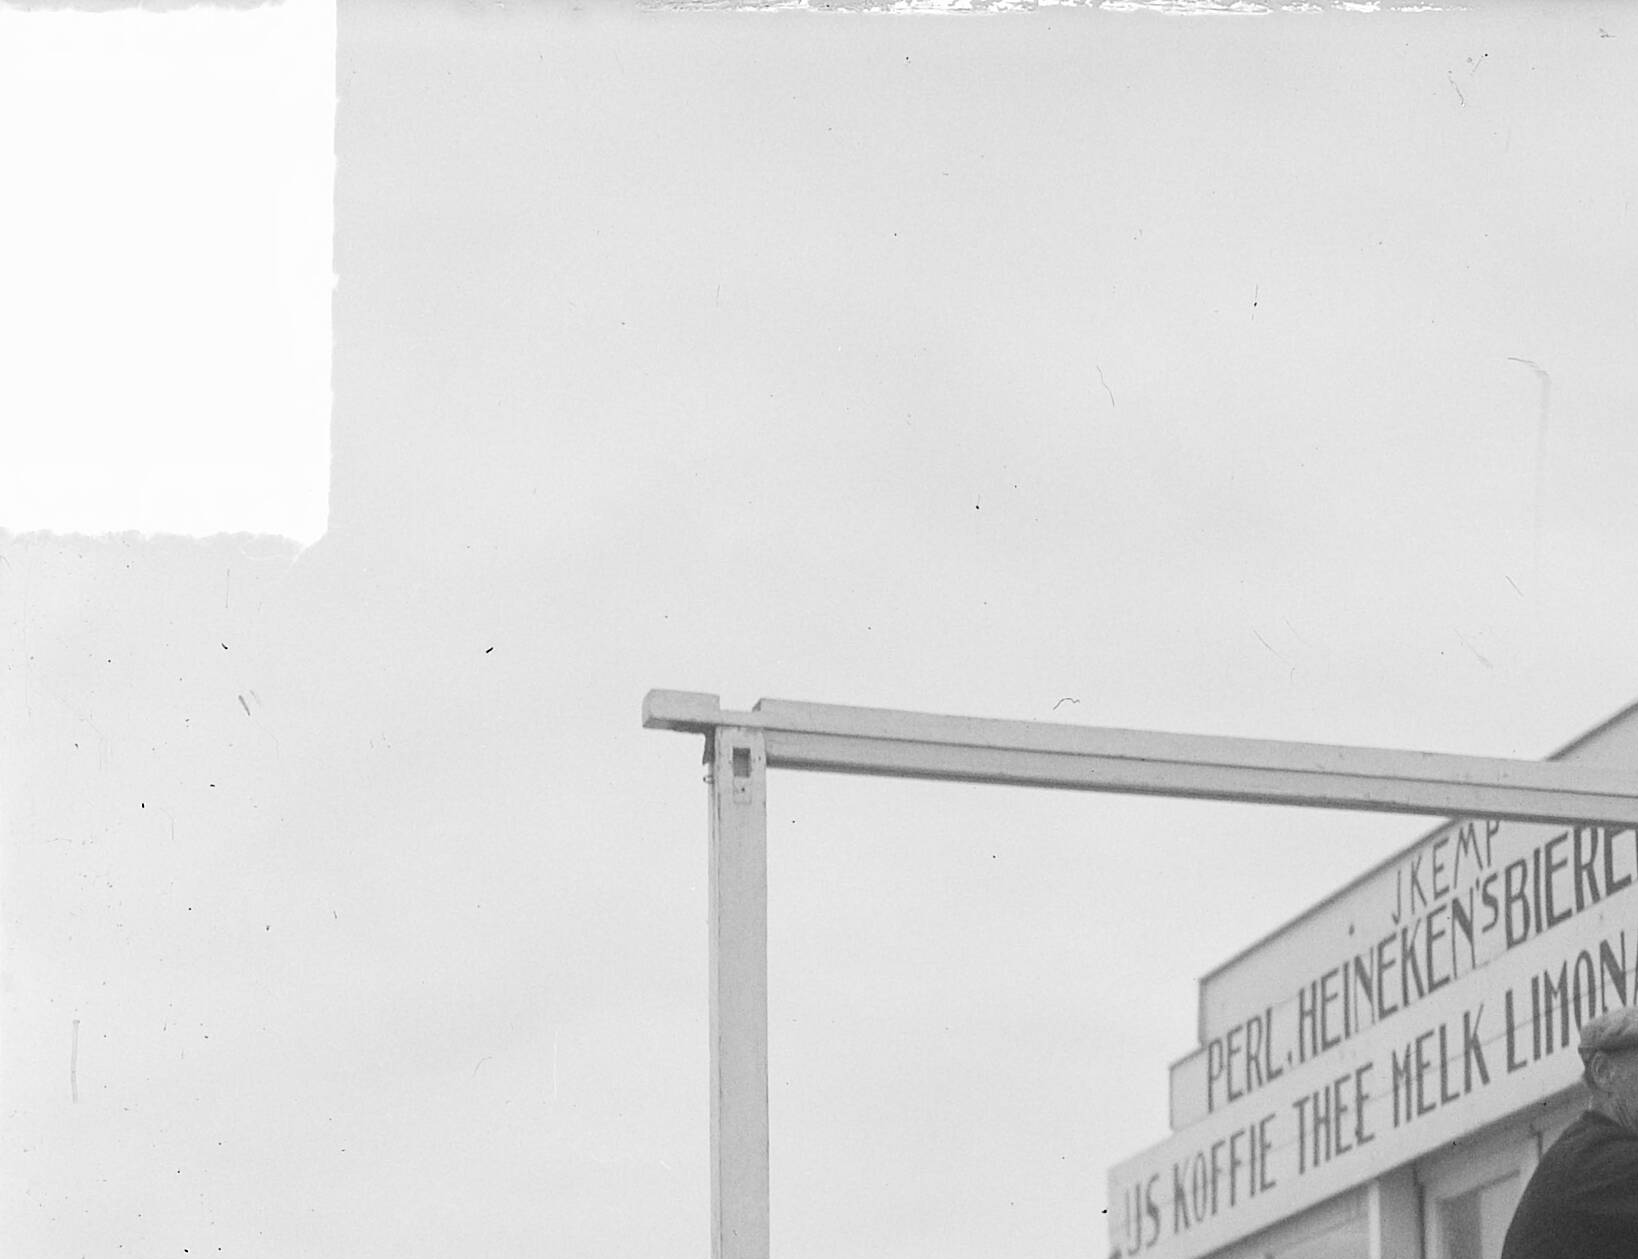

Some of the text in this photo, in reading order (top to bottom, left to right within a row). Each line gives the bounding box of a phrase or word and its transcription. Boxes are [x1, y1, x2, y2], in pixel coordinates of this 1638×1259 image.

[1173, 1113, 1277, 1234] KOFFIE
[1293, 1060, 1376, 1174] THEE
[1391, 1003, 1492, 1127] MELK
